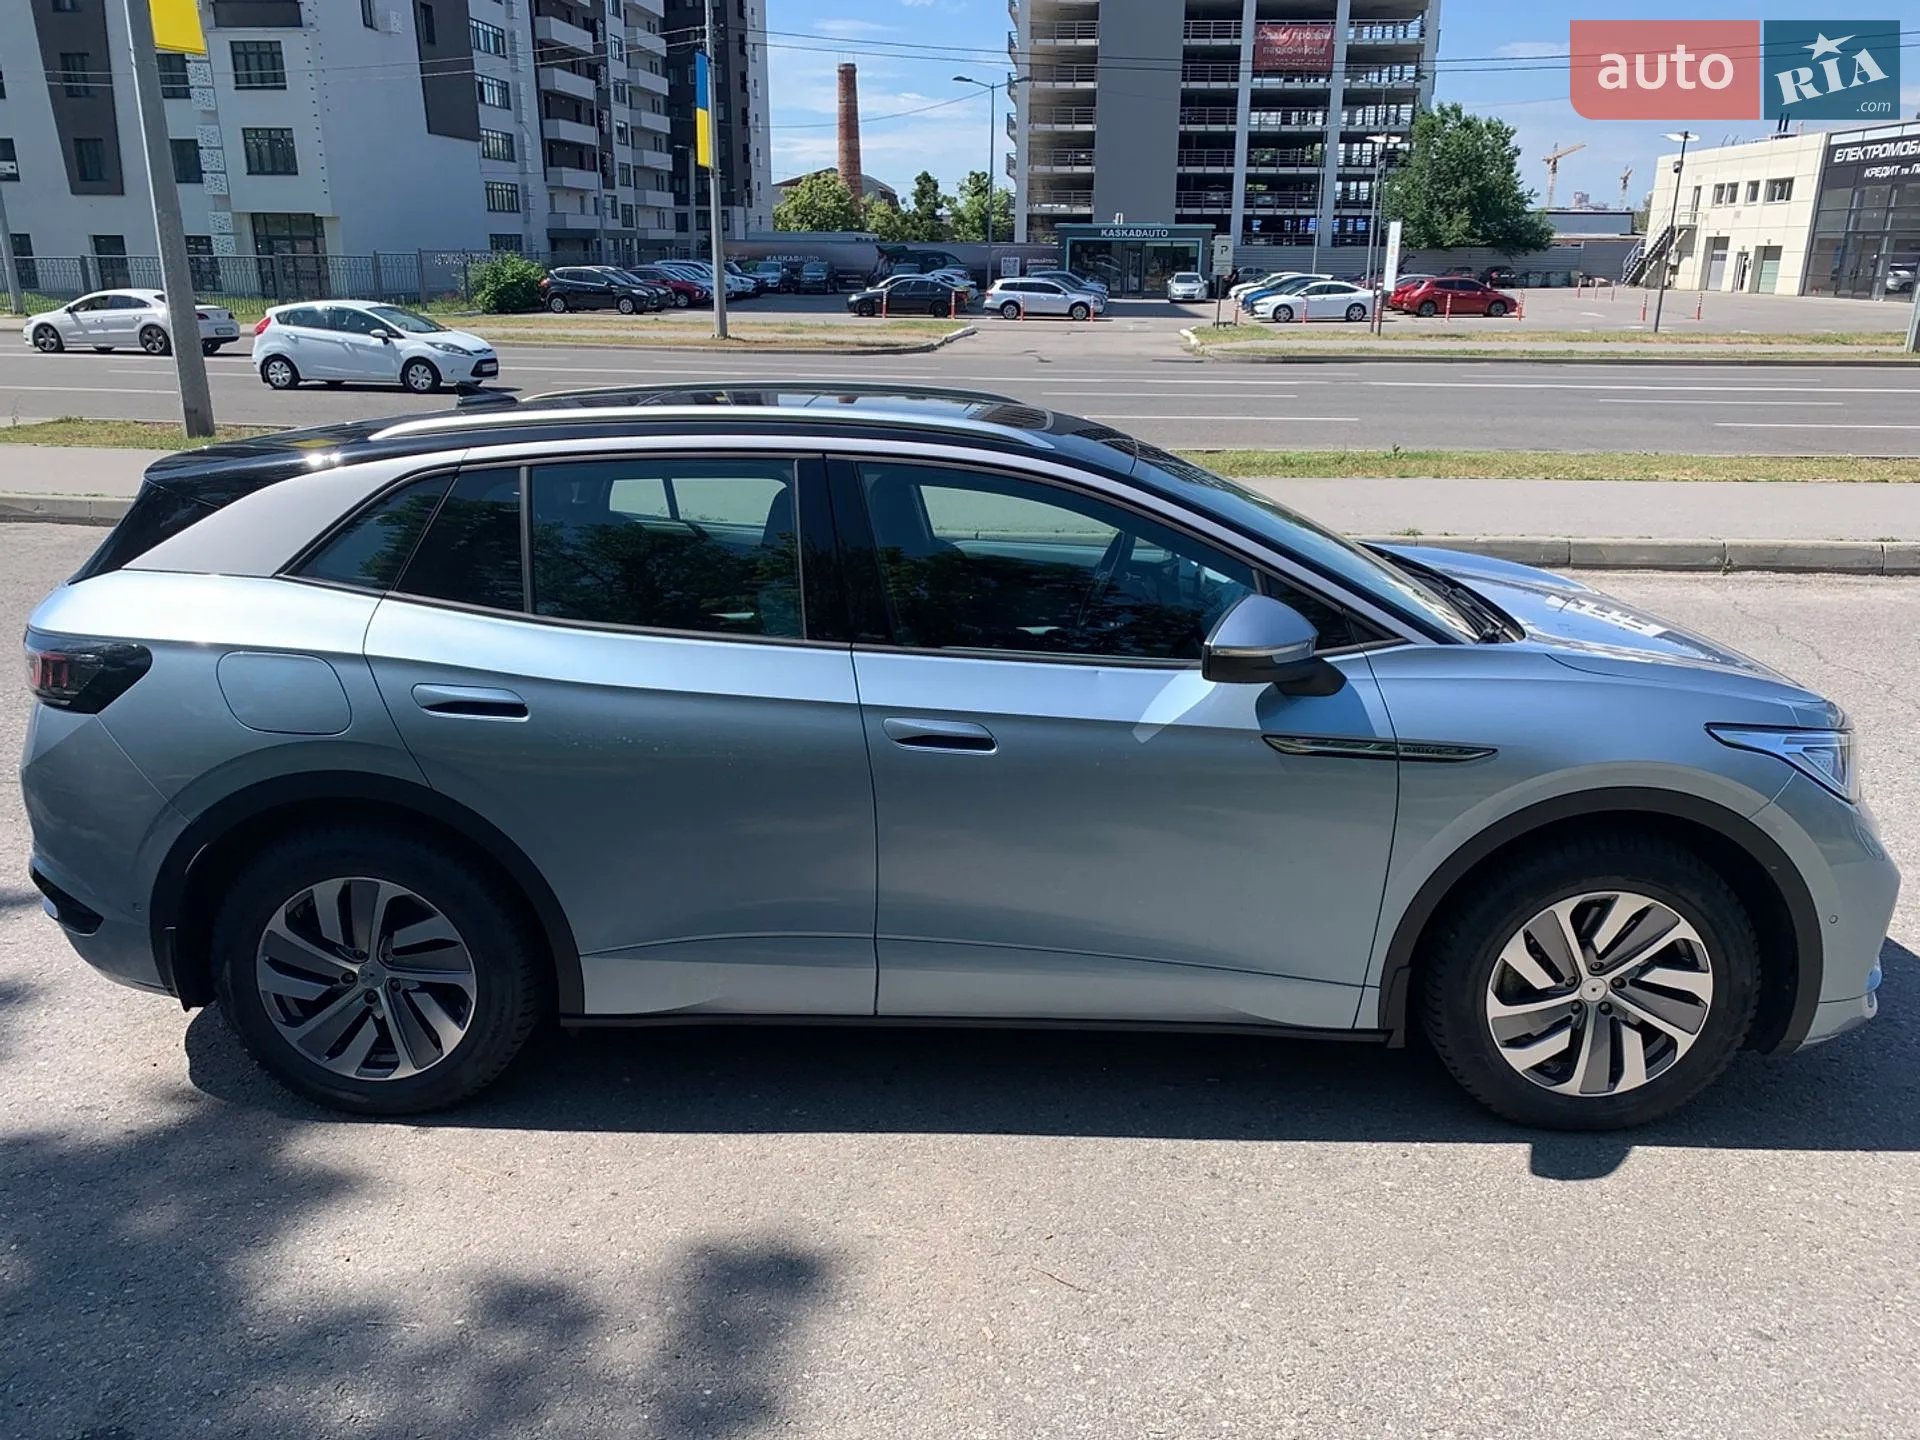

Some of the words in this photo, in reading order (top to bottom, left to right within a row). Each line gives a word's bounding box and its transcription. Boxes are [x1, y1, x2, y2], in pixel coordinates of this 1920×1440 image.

[1833, 139, 1920, 163] ЕЛЕКТРОМОБ
[1863, 165, 1902, 179] КРЕДИТ
[1101, 229, 1169, 238] KASKADAUTO
[1220, 245, 1229, 255] P
